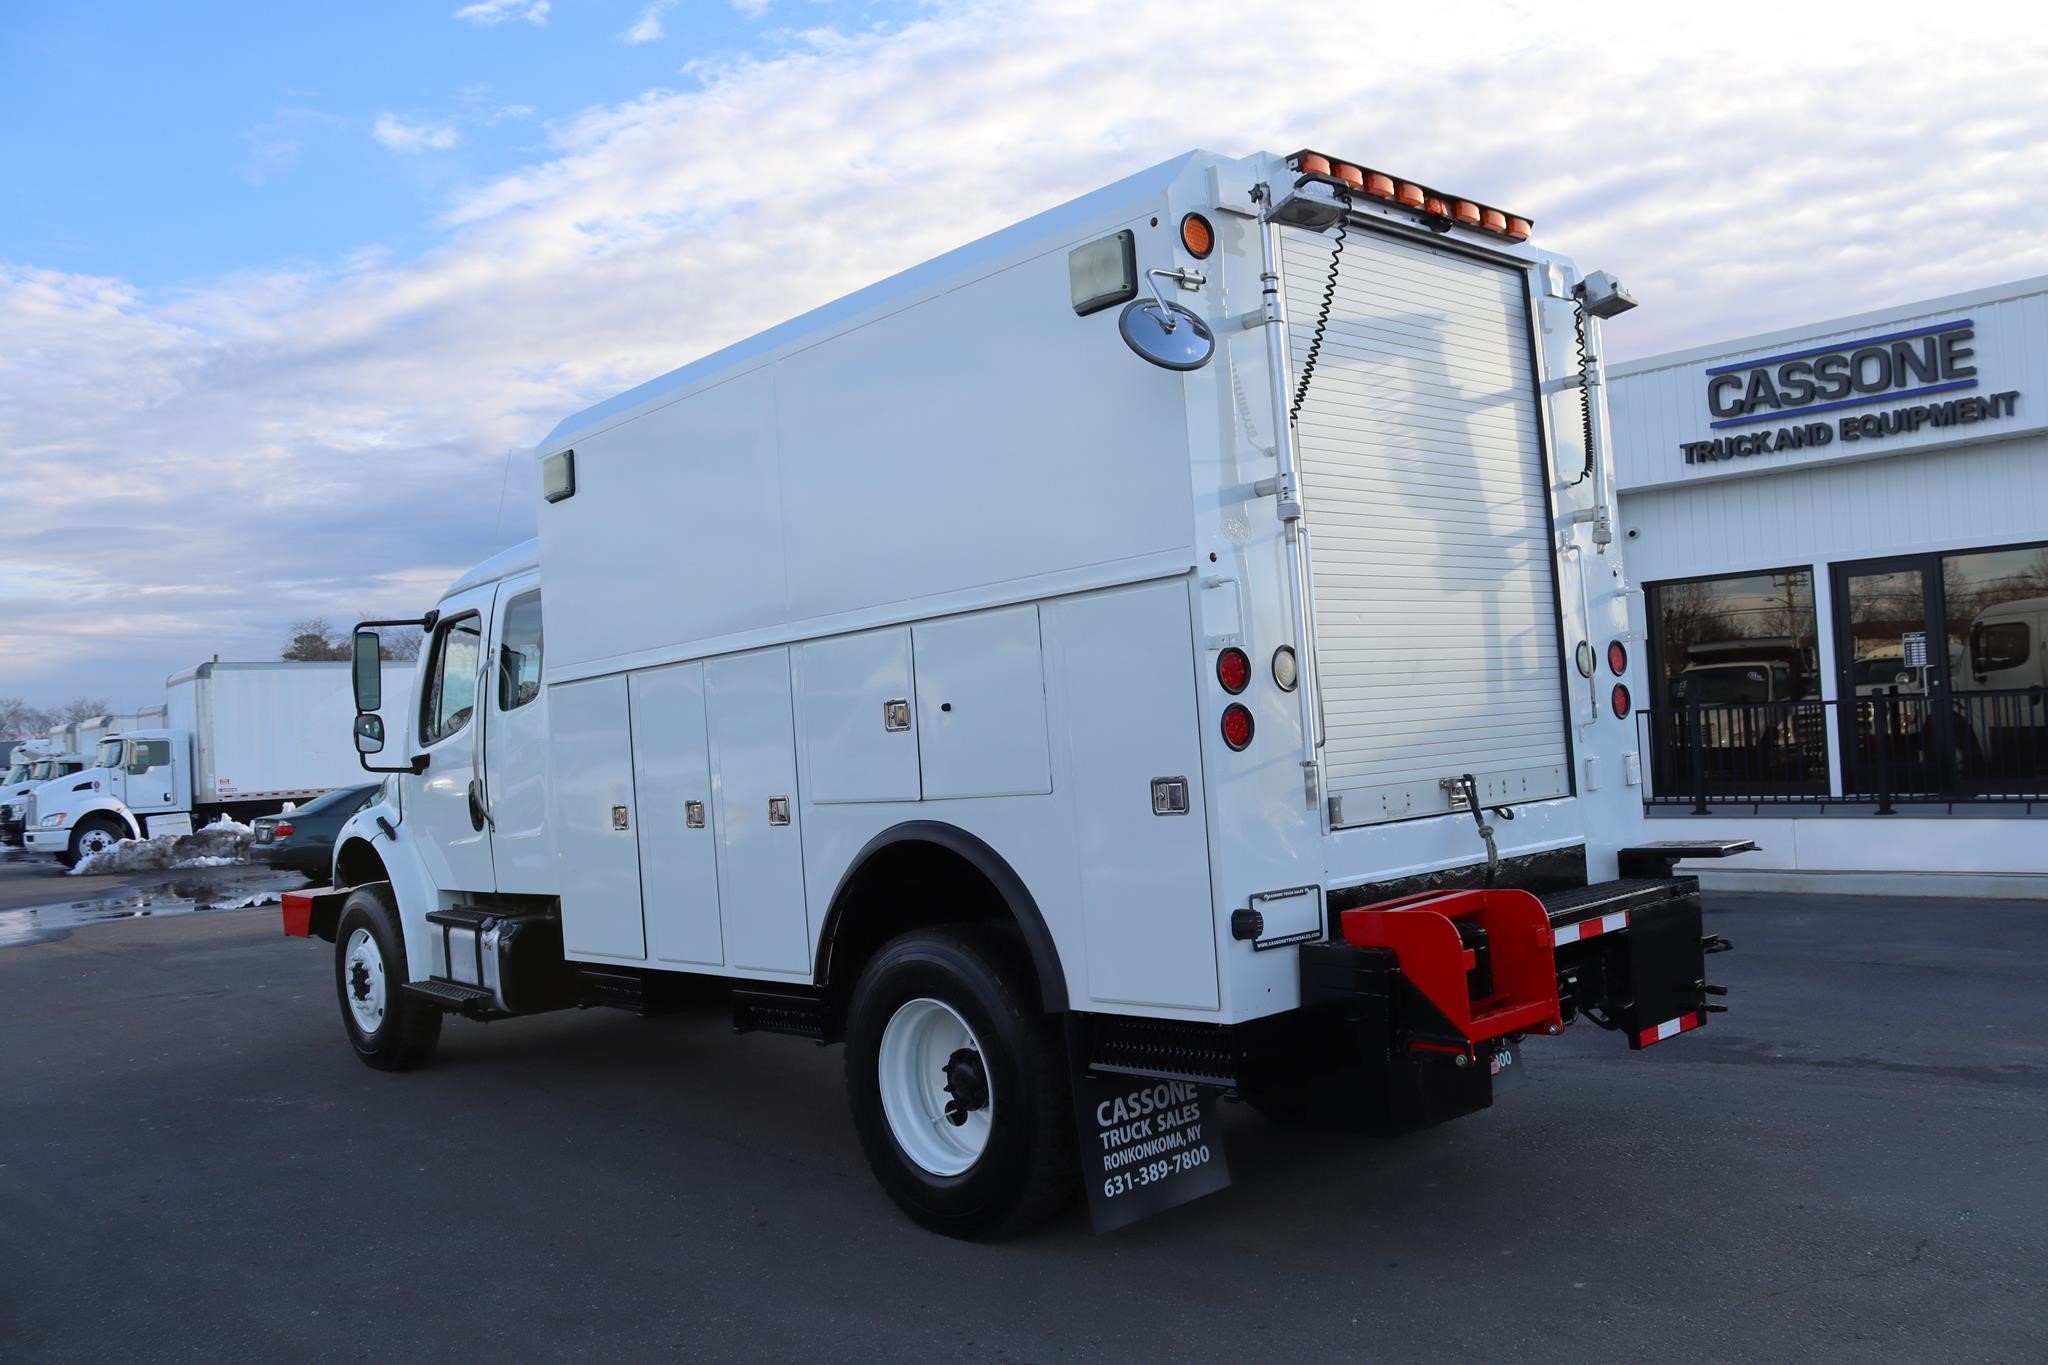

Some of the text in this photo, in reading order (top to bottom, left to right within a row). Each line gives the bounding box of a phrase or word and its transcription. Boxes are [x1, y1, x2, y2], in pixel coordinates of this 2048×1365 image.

[1707, 329, 1977, 418] CASSONE
[1839, 390, 2020, 442] EQUIPMENT
[1096, 1081, 1198, 1127] CASSONE
[1100, 1102, 1200, 1150] TRUCK SALES
[1103, 1125, 1201, 1171] RONKONKOMA, NY
[1104, 1145, 1210, 1198] 631-389-7800
